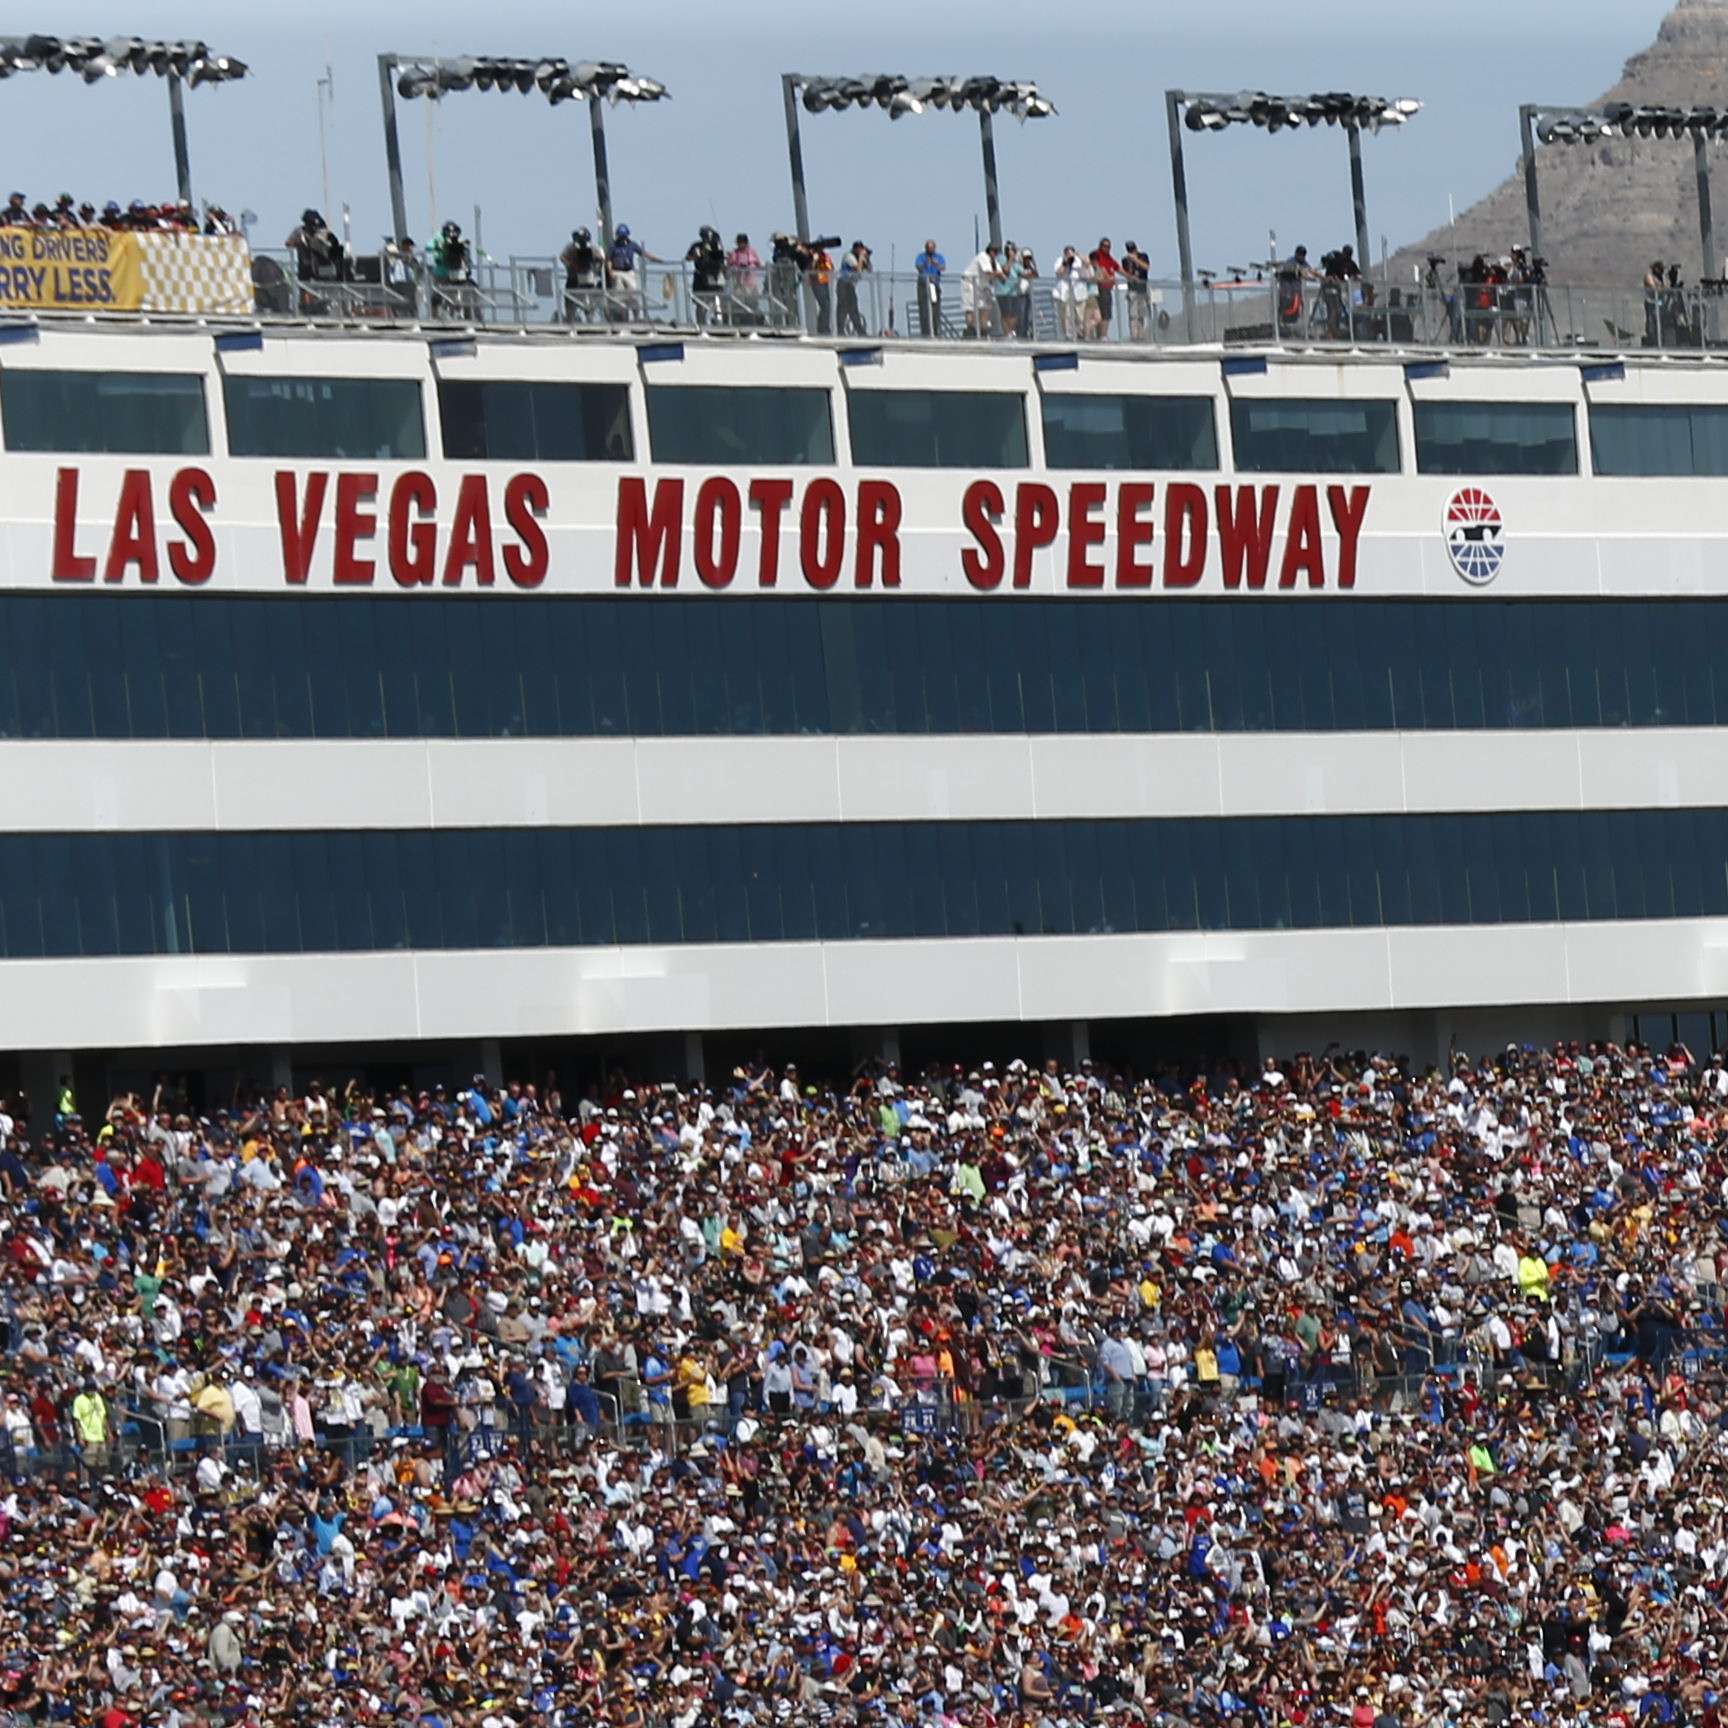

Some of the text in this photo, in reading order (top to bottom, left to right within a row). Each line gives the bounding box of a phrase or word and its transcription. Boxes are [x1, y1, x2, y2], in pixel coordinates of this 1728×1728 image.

[32, 235, 110, 263] DRIVERS
[53, 467, 1371, 588] LAS VEGAS MOTOR SPEEDWAY
